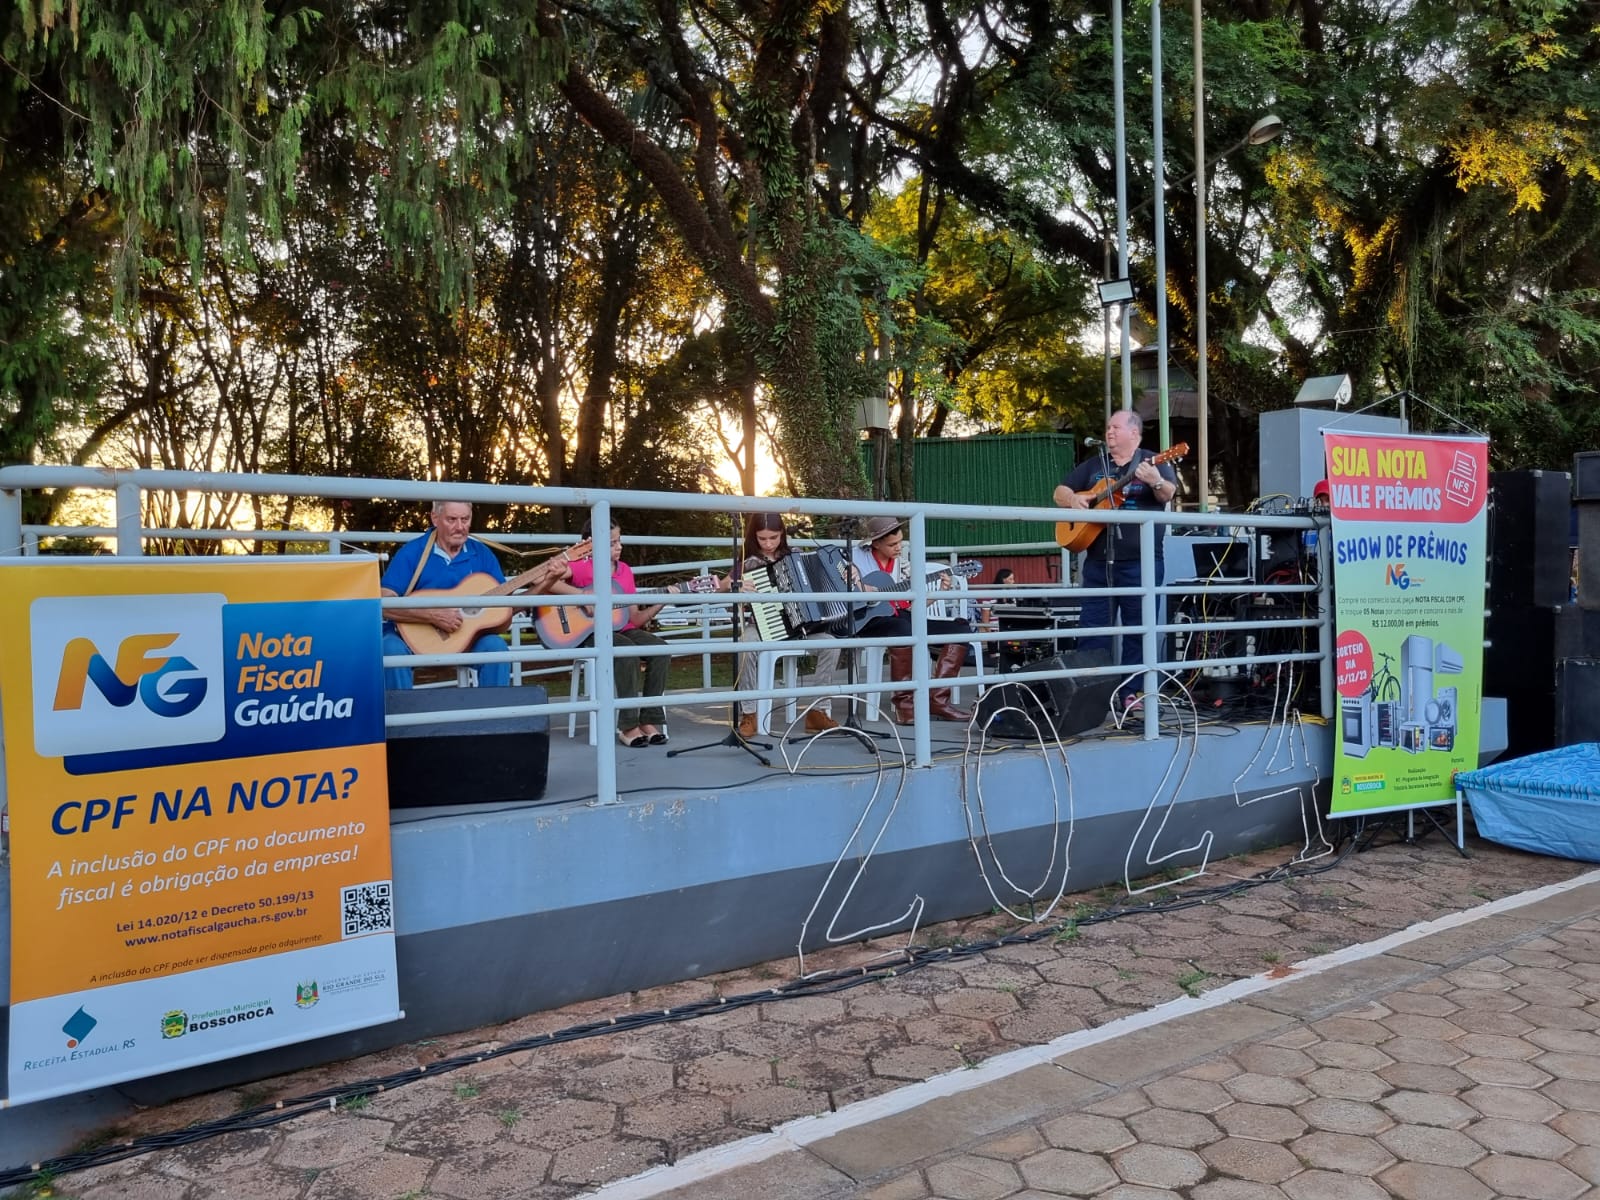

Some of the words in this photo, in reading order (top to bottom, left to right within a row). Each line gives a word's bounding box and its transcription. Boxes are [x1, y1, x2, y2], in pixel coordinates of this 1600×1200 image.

[1331, 446, 1371, 478] SUA
[1377, 448, 1427, 480] NOTA
[1331, 484, 1371, 509] VALE
[1375, 480, 1442, 511] PRÊMIOS
[1452, 476, 1470, 494] NFS
[1337, 535, 1381, 565] SHOW
[1386, 534, 1403, 559] DE
[1407, 530, 1468, 565] PRÊMIOS
[1385, 563, 1410, 590] NFG
[236, 632, 313, 660] Nota
[52, 632, 208, 718] NFG
[236, 660, 324, 694] Fiscal
[1345, 658, 1356, 670] DIA
[233, 691, 354, 727] Gaúcha
[51, 794, 138, 836] CPF
[149, 786, 213, 825] NA
[227, 766, 359, 814] NOTA?
[47, 860, 63, 879] A
[70, 850, 157, 877] inclusão
[162, 844, 187, 864] do
[193, 838, 231, 858] CPF
[235, 837, 259, 853] no
[264, 821, 366, 849] documento
[56, 882, 116, 910] fiscal
[121, 879, 134, 897] é
[139, 864, 239, 893] obrigação
[244, 859, 268, 878] da
[273, 844, 360, 873] empresa!
[116, 920, 134, 934] Lei
[137, 909, 198, 931] 14.020/12
[201, 909, 208, 918] e
[211, 901, 256, 917] Decreto
[258, 890, 315, 908] 50.199/13
[124, 906, 309, 948] www.notafiscalgaucha.rs.gov.br
[90, 974, 98, 984] A
[99, 967, 138, 983] inclusão
[139, 964, 152, 975] do
[153, 961, 171, 973] CPF
[171, 957, 194, 971] pode
[195, 955, 209, 965] ser
[210, 944, 258, 963] dispensada
[258, 940, 278, 953] pelo
[189, 1006, 275, 1033] BOSSOROCA
[191, 1005, 232, 1021] Prefeitura
[233, 998, 272, 1013] Municipal
[122, 1038, 137, 1051] RS
